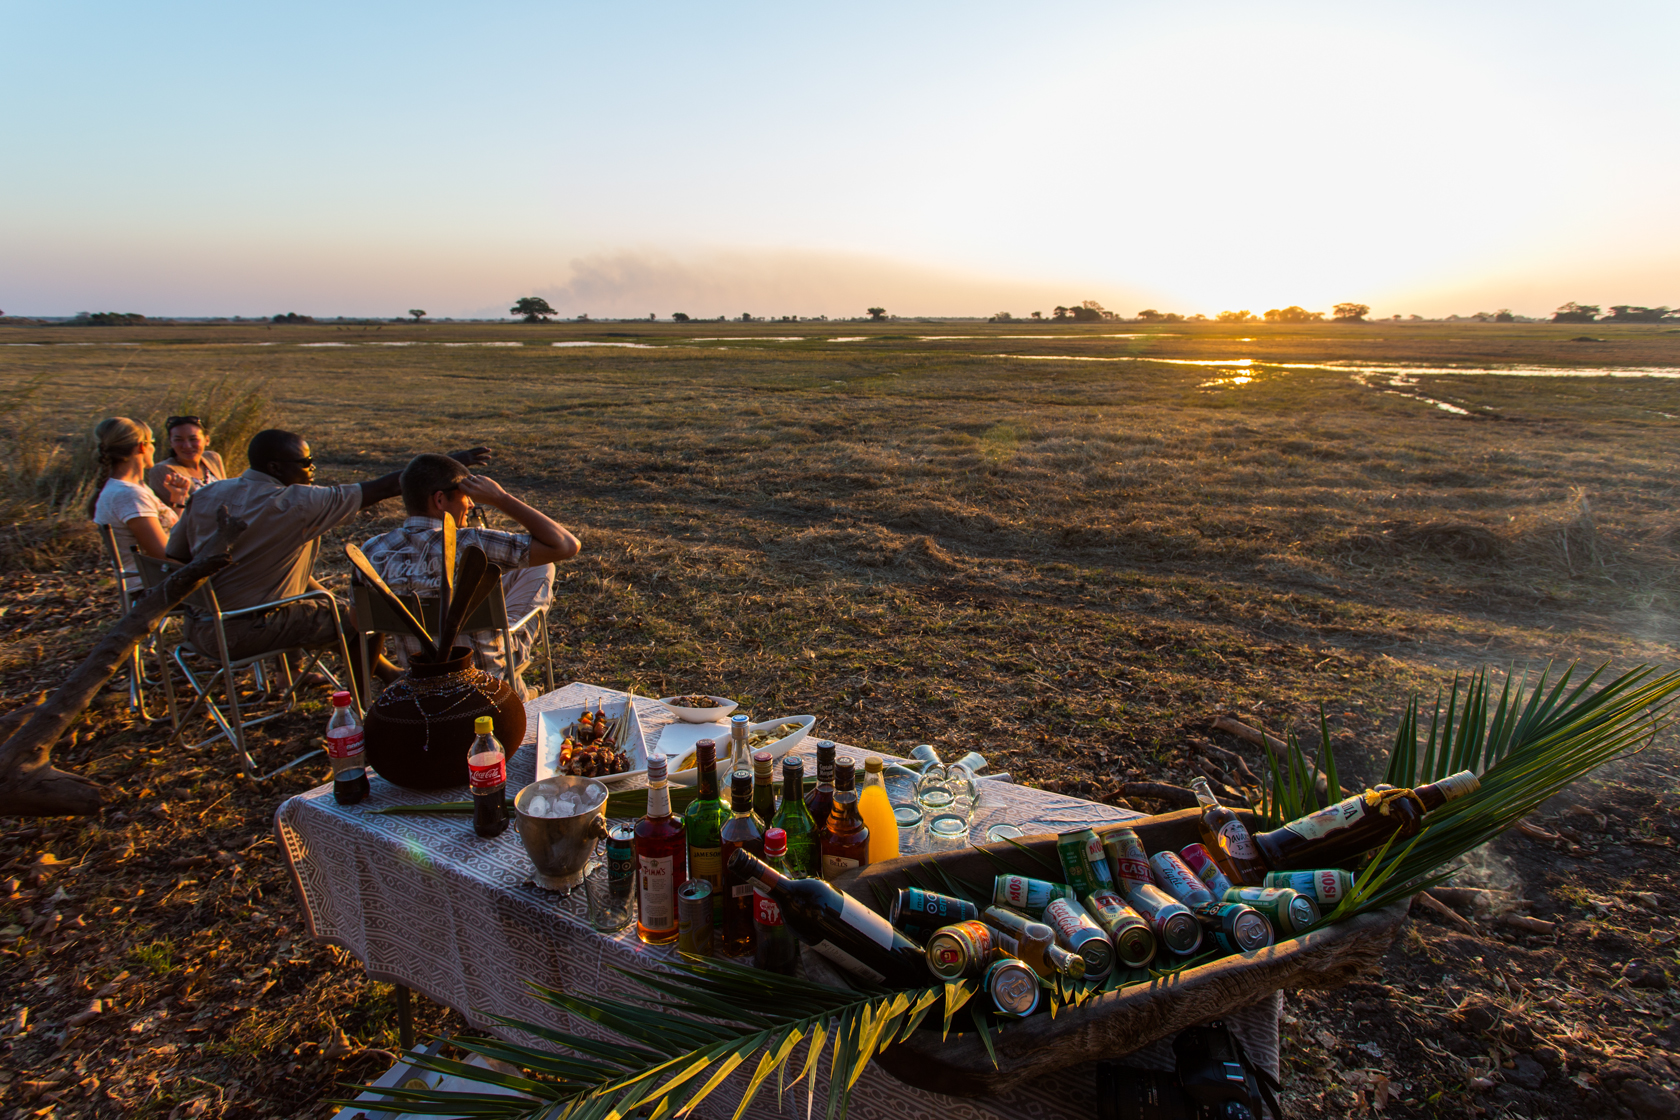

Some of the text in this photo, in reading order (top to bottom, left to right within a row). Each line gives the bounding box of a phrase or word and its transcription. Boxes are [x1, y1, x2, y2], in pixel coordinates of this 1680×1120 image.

[370, 542, 441, 580] Turbo
[473, 767, 500, 779] Coca-Cola
[1089, 840, 1104, 855] MO
[1224, 829, 1250, 848] Sava
[644, 867, 666, 876] PIMM'S
[1121, 862, 1155, 879] CASTL
[1321, 871, 1337, 899] MOSI
[1047, 901, 1089, 938] Coca-Cola
